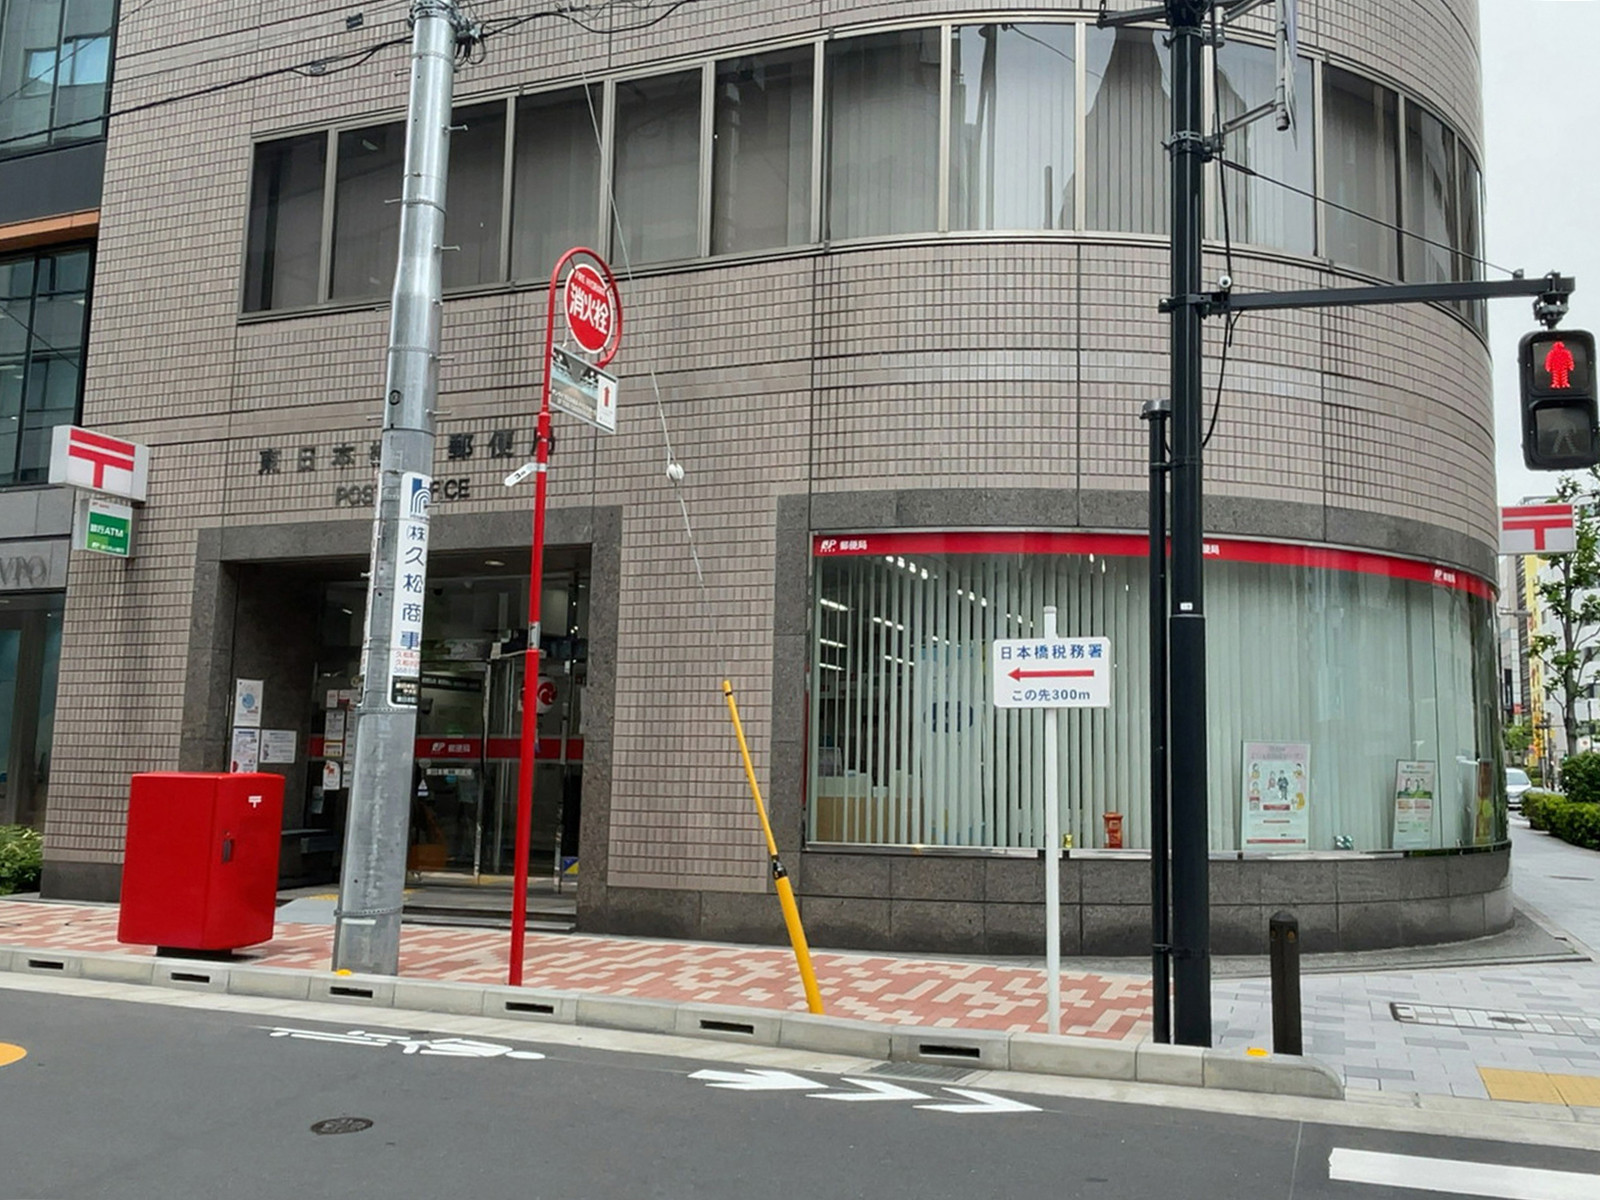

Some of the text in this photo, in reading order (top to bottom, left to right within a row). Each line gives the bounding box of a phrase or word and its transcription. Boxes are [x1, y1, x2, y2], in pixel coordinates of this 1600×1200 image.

[569, 282, 609, 334] 消火栓
[336, 483, 379, 506] POS
[1000, 643, 1103, 660] 日本橋税務署
[1011, 688, 1091, 702] この先300m
